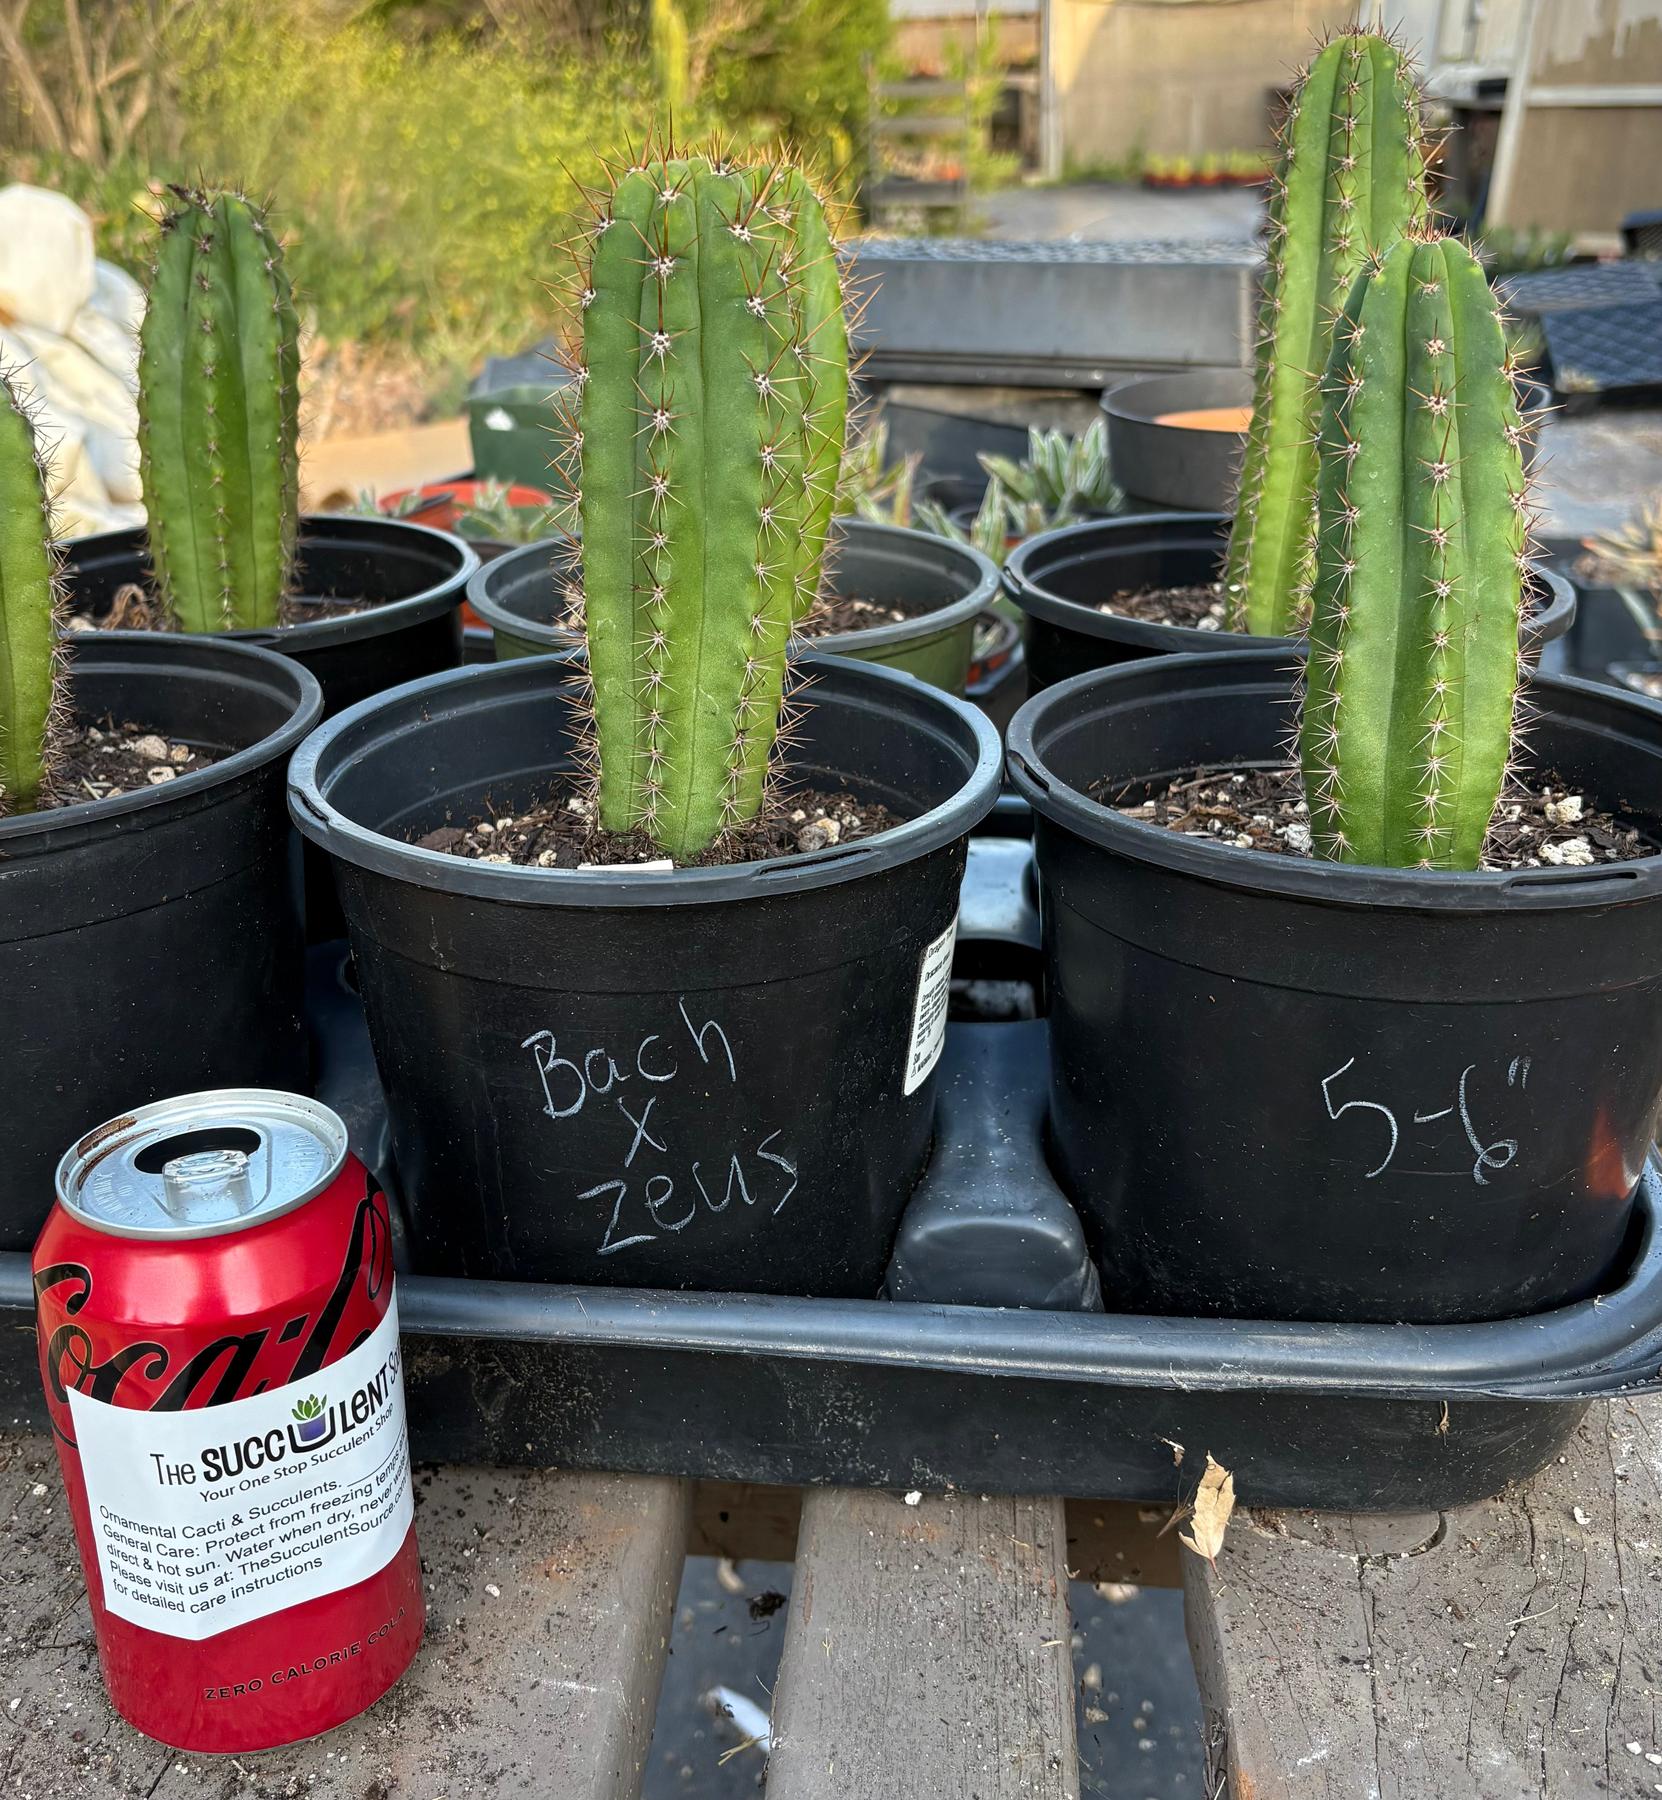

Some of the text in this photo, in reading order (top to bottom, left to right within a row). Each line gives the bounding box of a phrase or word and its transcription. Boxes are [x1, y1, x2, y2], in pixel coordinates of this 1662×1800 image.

[521, 994, 736, 1119] Bach
[200, 1403, 393, 1502] Your One Stop Succulent Shop
[100, 1480, 342, 1539] Ornamental Cacti & Succulents.
[103, 1524, 153, 1553] General
[156, 1543, 200, 1558] Care:
[205, 1523, 266, 1554] Protect
[269, 1509, 306, 1531] from
[310, 1482, 373, 1515] freezing
[375, 1450, 399, 1486] temps
[107, 1543, 140, 1567] direct
[143, 1557, 153, 1571] &
[157, 1560, 181, 1577] hot
[185, 1561, 220, 1577] sun.
[225, 1538, 275, 1563] Water
[279, 1520, 322, 1544] when
[326, 1509, 355, 1525] dry,
[360, 1482, 393, 1514] never
[110, 1560, 152, 1588] Please
[155, 1579, 185, 1596] visit
[189, 1581, 209, 1596] us
[213, 1570, 235, 1587] at:
[113, 1557, 323, 1614] for detailed care instructions
[204, 1607, 407, 1700] ZERO CALORIE COLA
